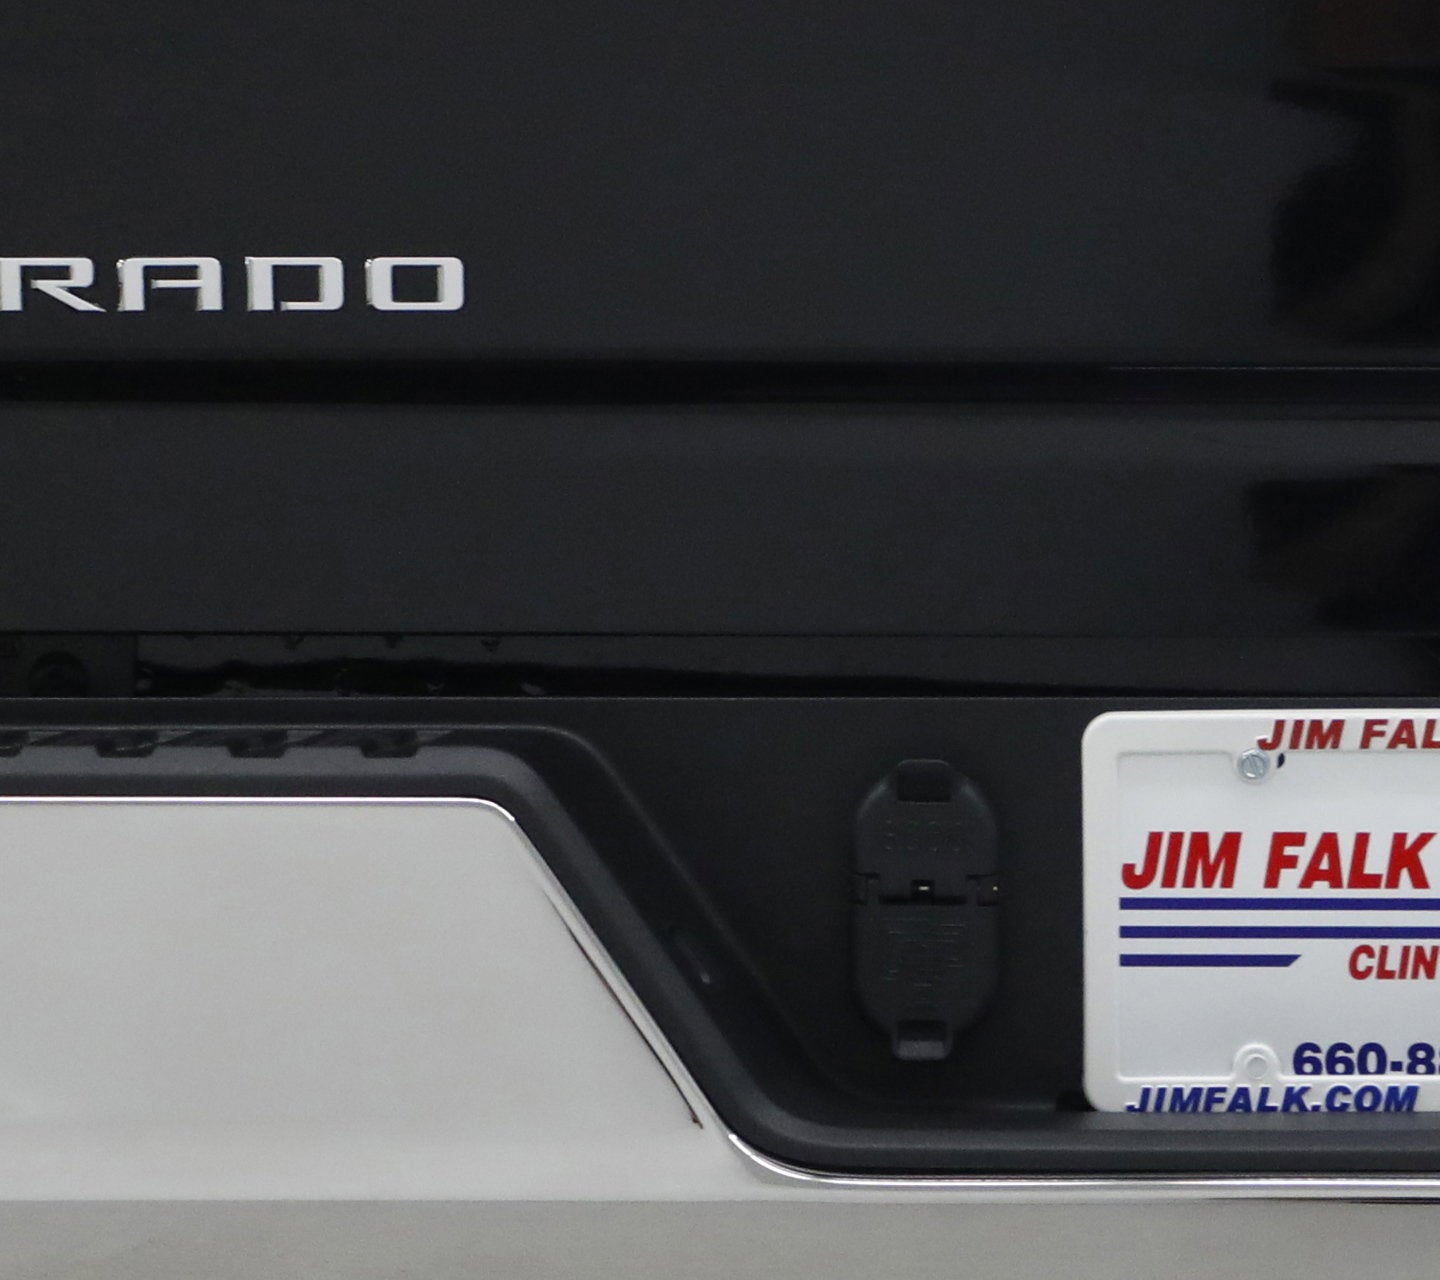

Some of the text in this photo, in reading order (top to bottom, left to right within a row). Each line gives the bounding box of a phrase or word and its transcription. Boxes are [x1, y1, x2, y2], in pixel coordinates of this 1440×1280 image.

[1257, 719, 1345, 751] JIM
[1121, 832, 1243, 890] JIM
[1263, 832, 1438, 890] FALK
[1125, 1085, 1419, 1113] JIMFALK.COM
